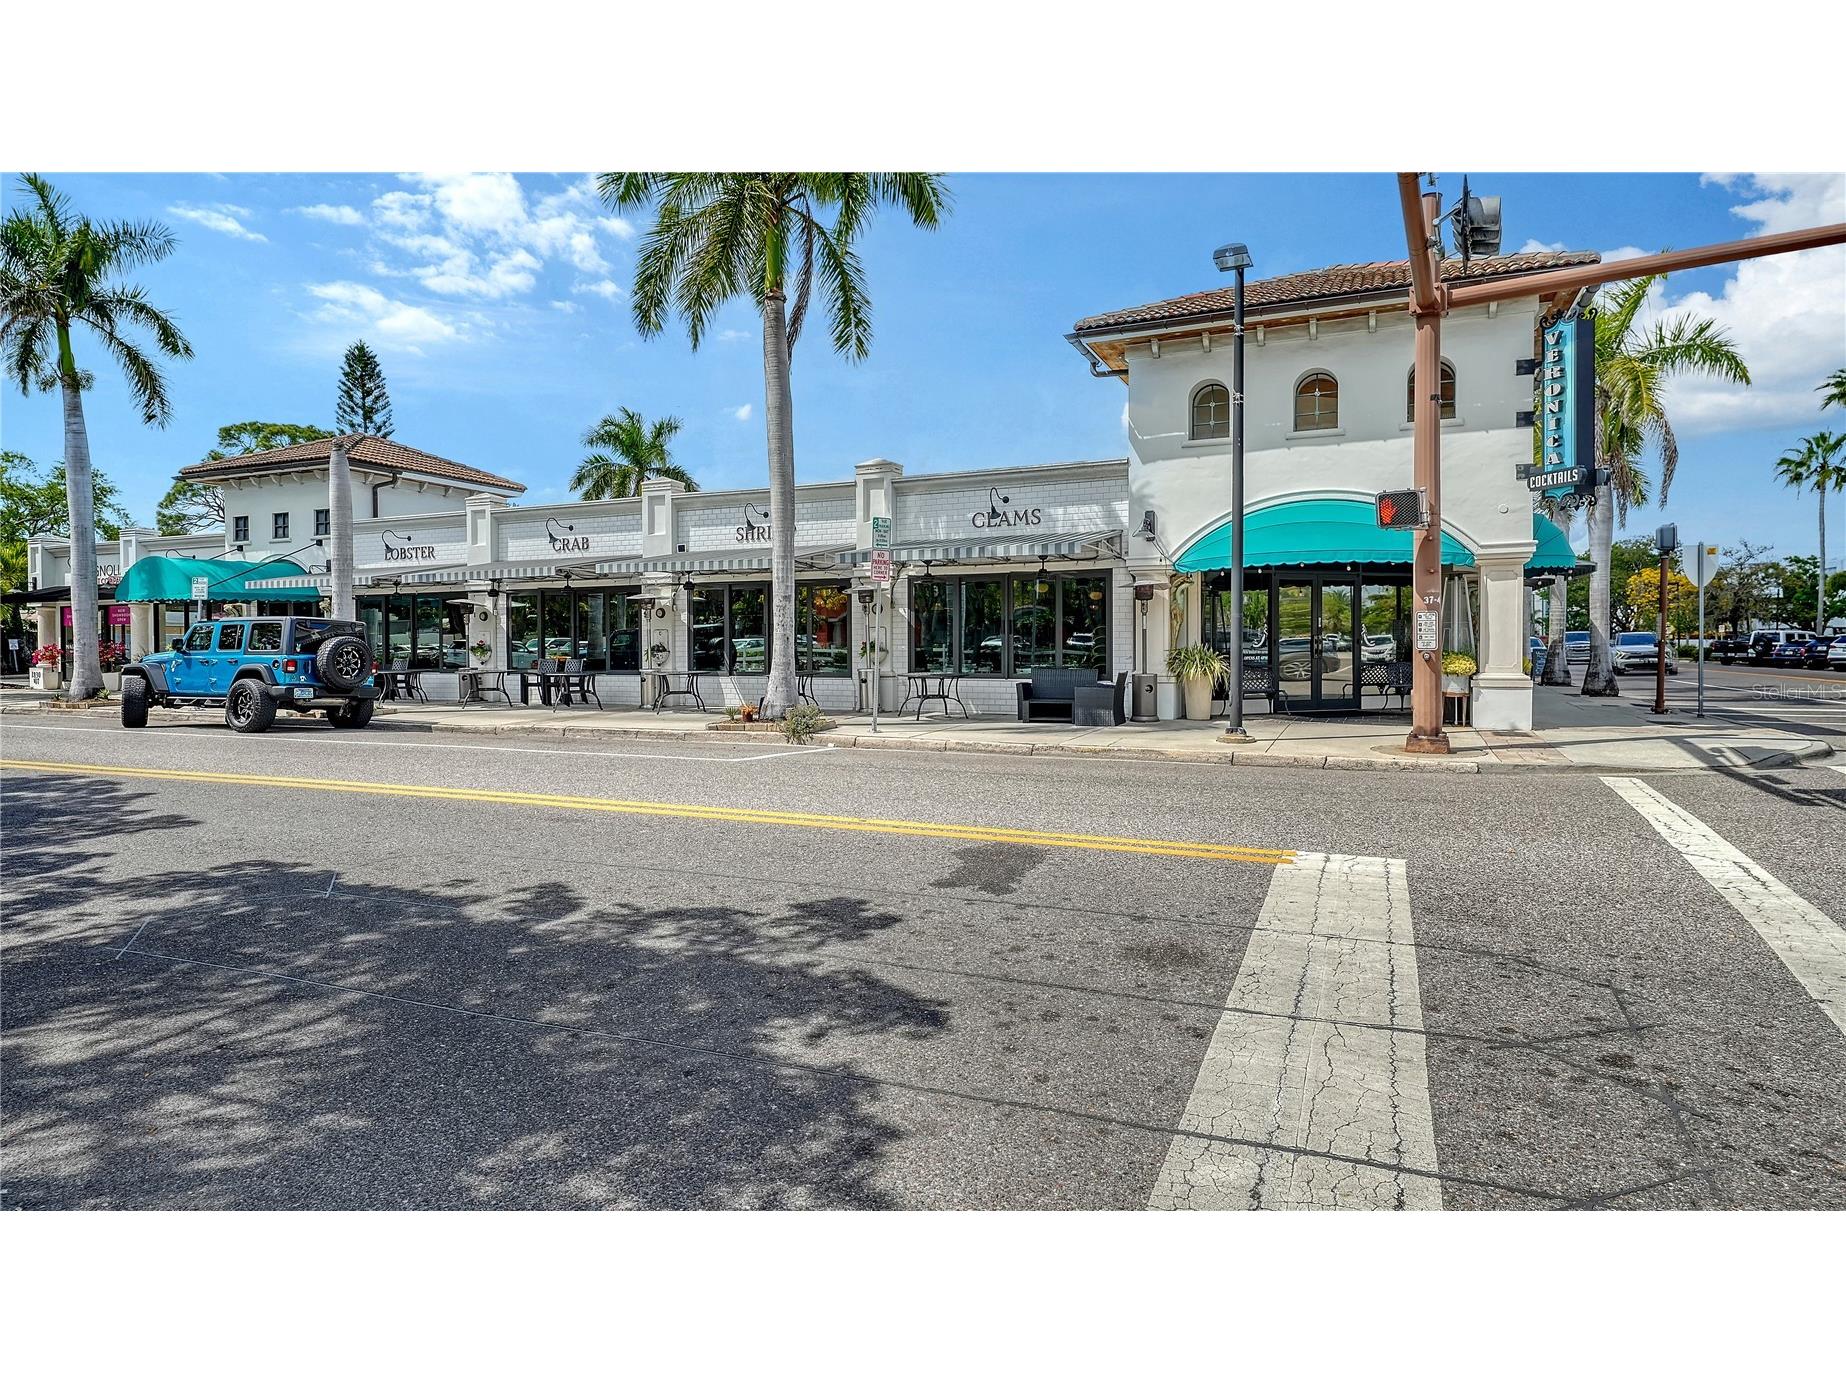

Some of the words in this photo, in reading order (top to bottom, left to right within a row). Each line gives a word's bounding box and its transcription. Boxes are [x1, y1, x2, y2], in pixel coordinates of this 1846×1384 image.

[1544, 330, 1564, 465] VERONICA
[1529, 469, 1578, 489] COCKTAILS
[874, 519, 879, 528] 2
[972, 508, 1041, 528] CLAMS
[736, 526, 772, 542] SHRI
[553, 537, 589, 552] CRAB
[384, 546, 436, 561] LOBSTER
